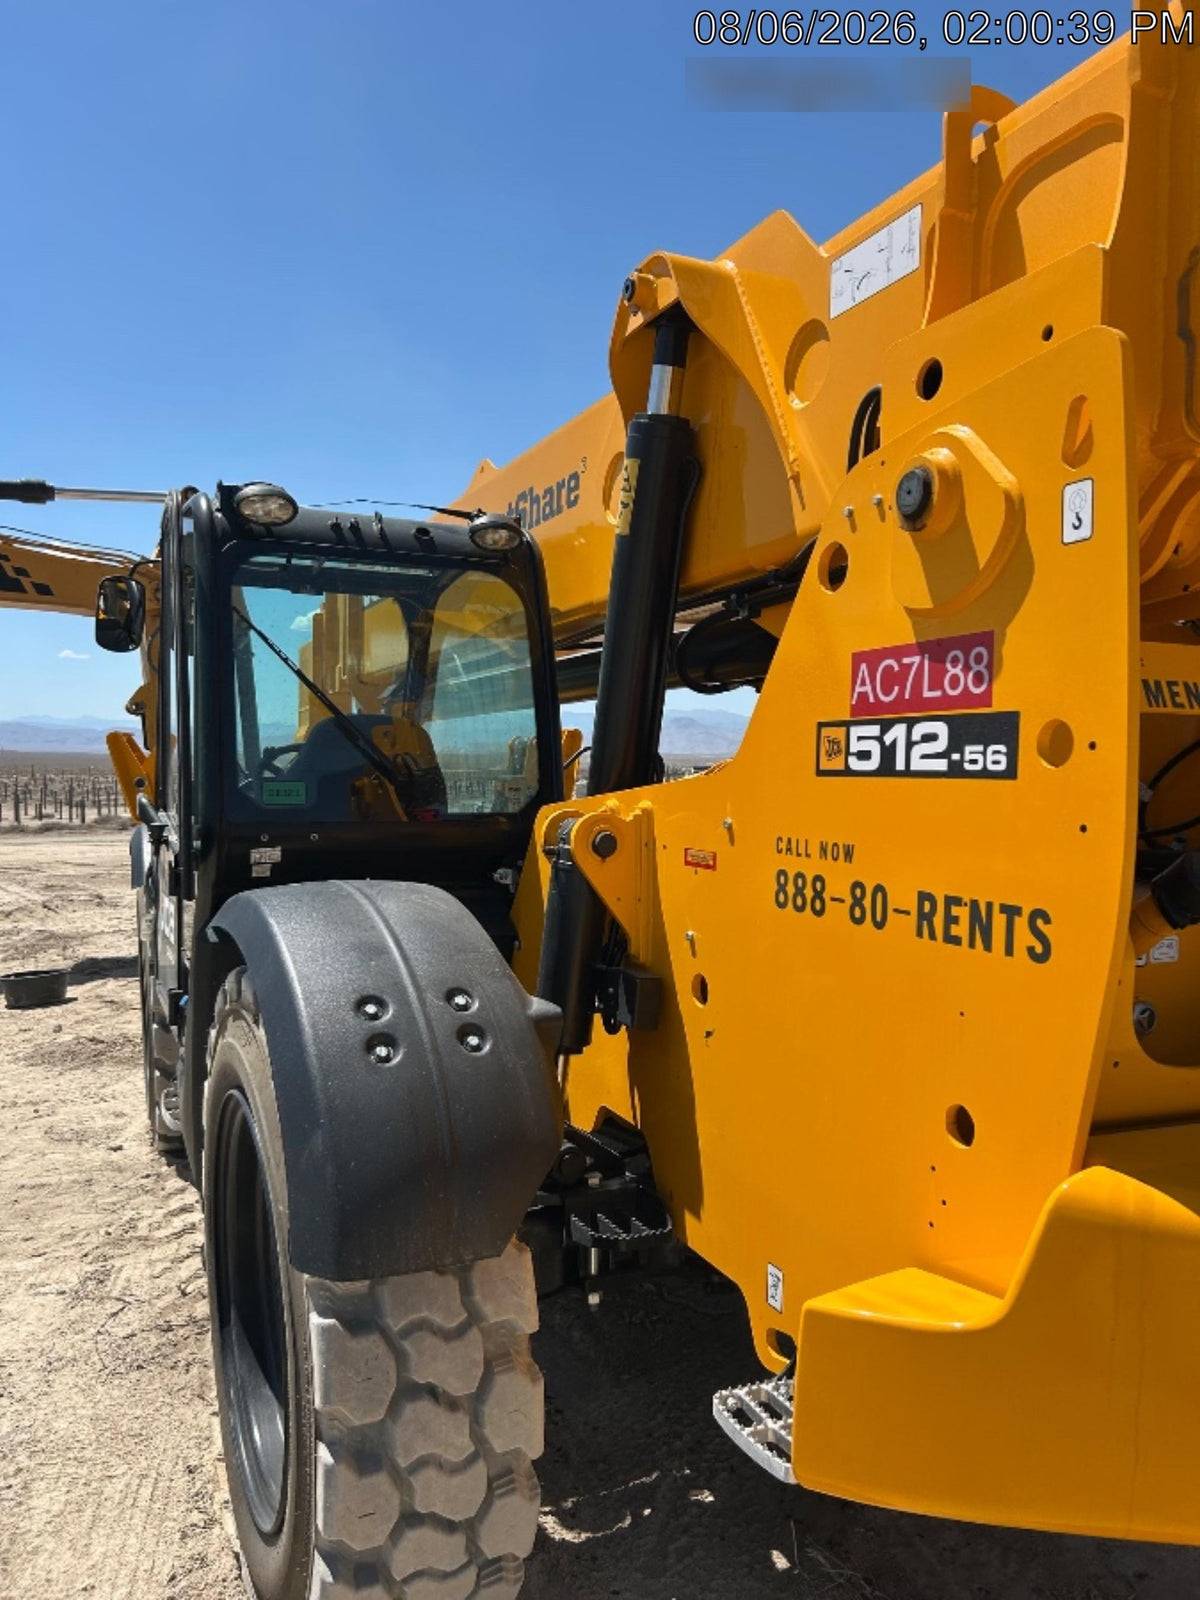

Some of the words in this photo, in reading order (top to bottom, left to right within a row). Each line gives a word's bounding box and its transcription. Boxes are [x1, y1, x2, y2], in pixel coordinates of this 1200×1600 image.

[851, 646, 990, 705] AC7L88
[848, 721, 1008, 771] 512-56
[776, 836, 812, 859] CALL
[819, 841, 855, 865] NOW
[775, 869, 1053, 965] 888-80-RENTS
